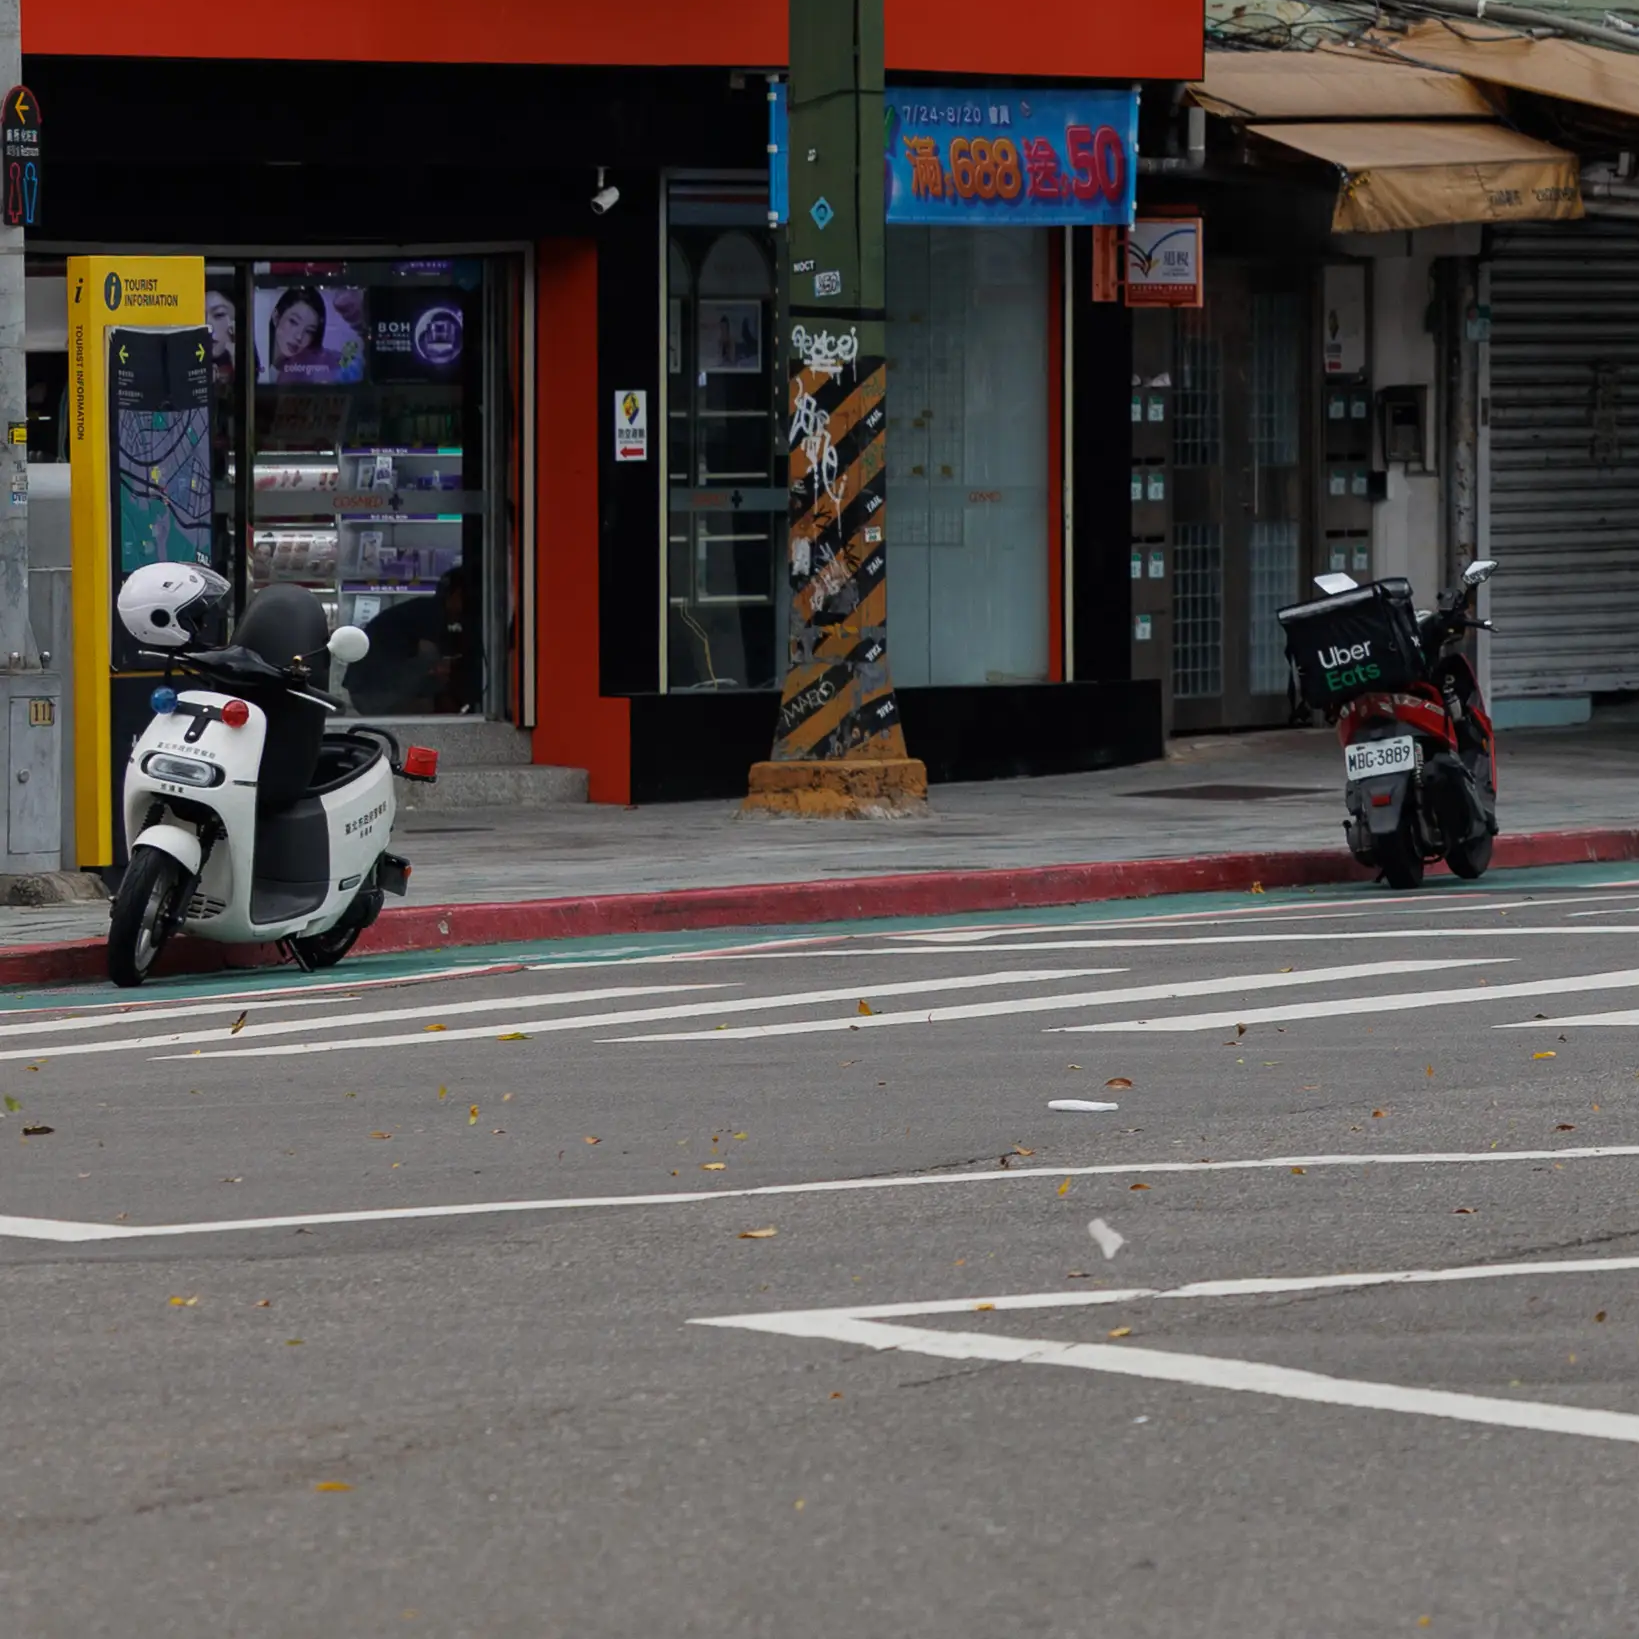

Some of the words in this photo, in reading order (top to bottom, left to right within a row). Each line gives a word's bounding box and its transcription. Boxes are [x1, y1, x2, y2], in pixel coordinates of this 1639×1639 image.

[125, 279, 158, 291] TOURIST
[125, 295, 178, 307] INFORMATION
[377, 321, 410, 332] BOH
[333, 496, 384, 509] COSMED
[1317, 640, 1372, 670] Uber
[1326, 662, 1381, 692] Eats
[1348, 745, 1412, 773] MBG-3889
